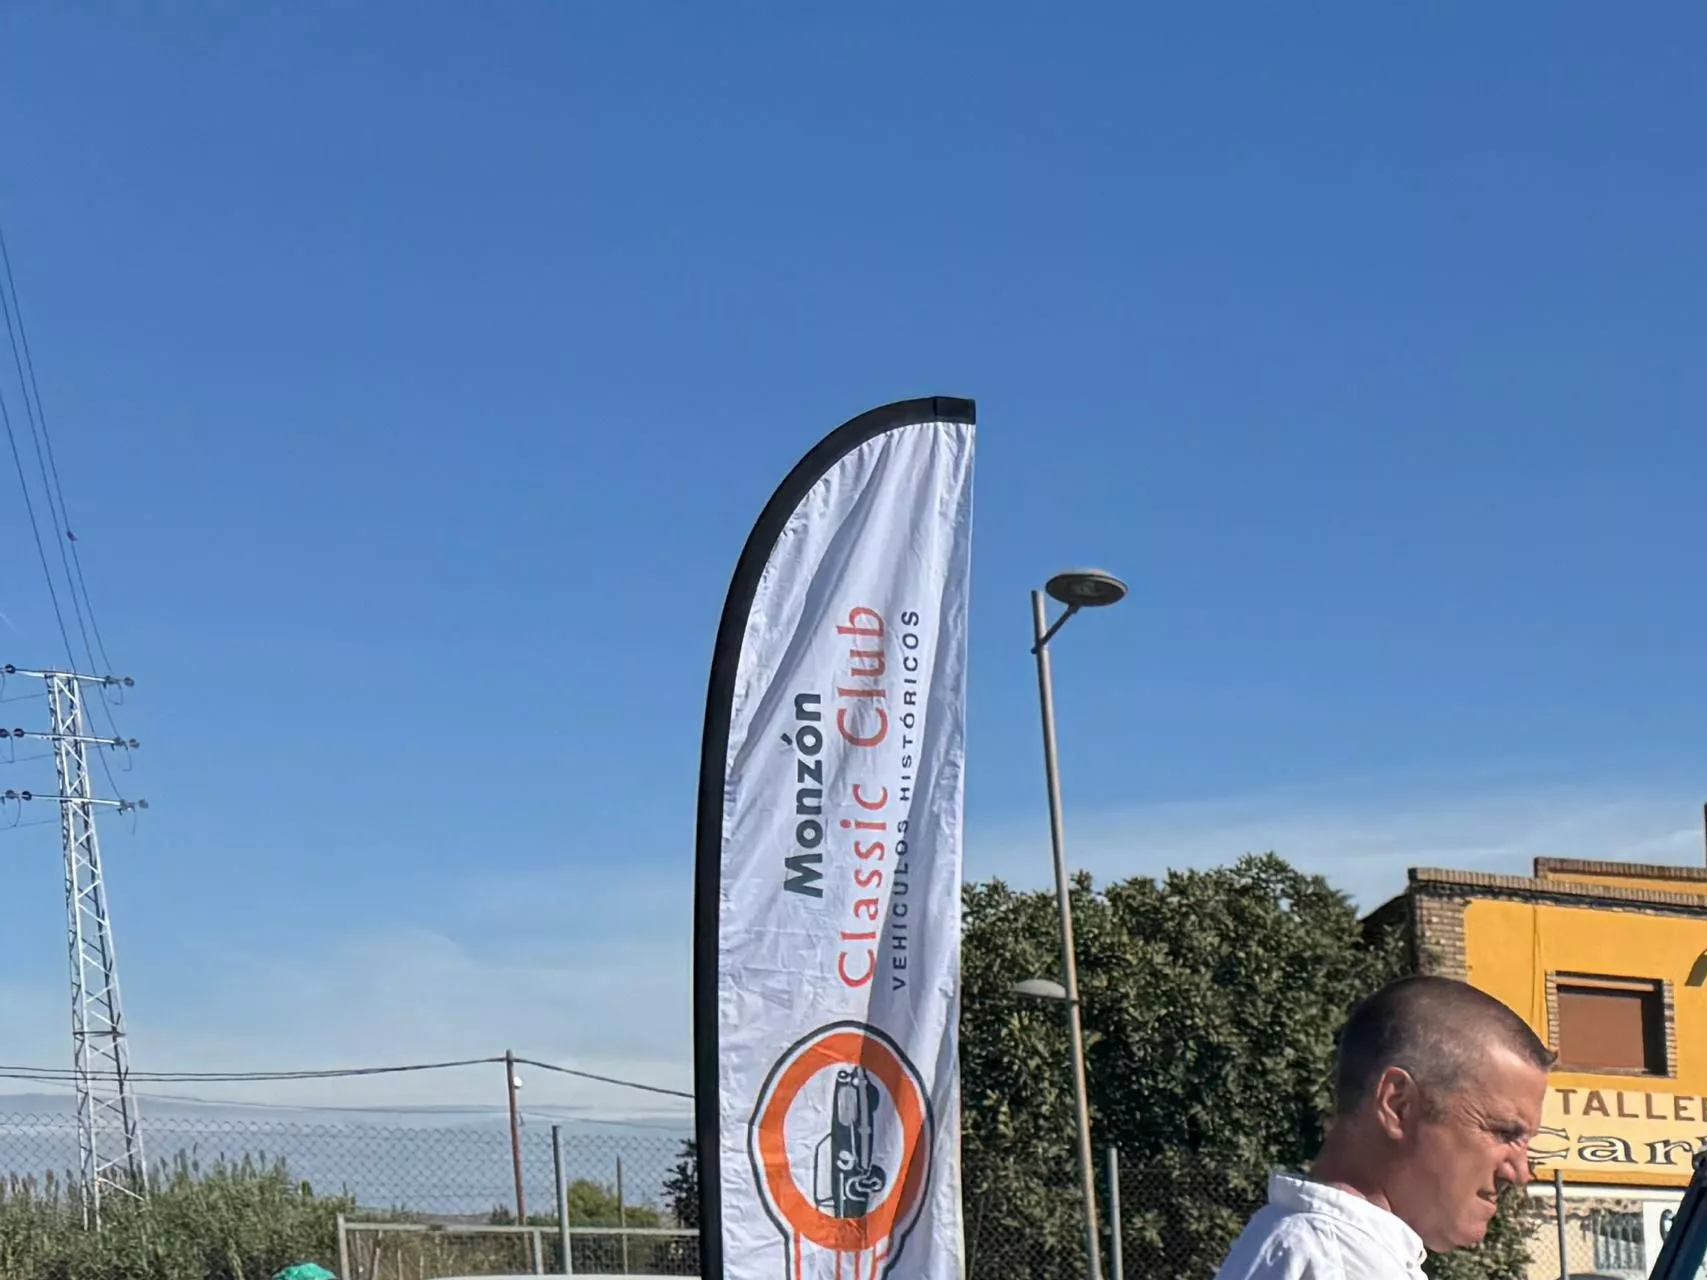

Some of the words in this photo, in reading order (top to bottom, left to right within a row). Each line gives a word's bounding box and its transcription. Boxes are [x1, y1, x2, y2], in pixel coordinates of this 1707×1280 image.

[836, 605, 890, 748] Club
[899, 610, 920, 802] HISTÓRICOS
[781, 692, 824, 898] Monzón
[837, 783, 889, 989] Classic
